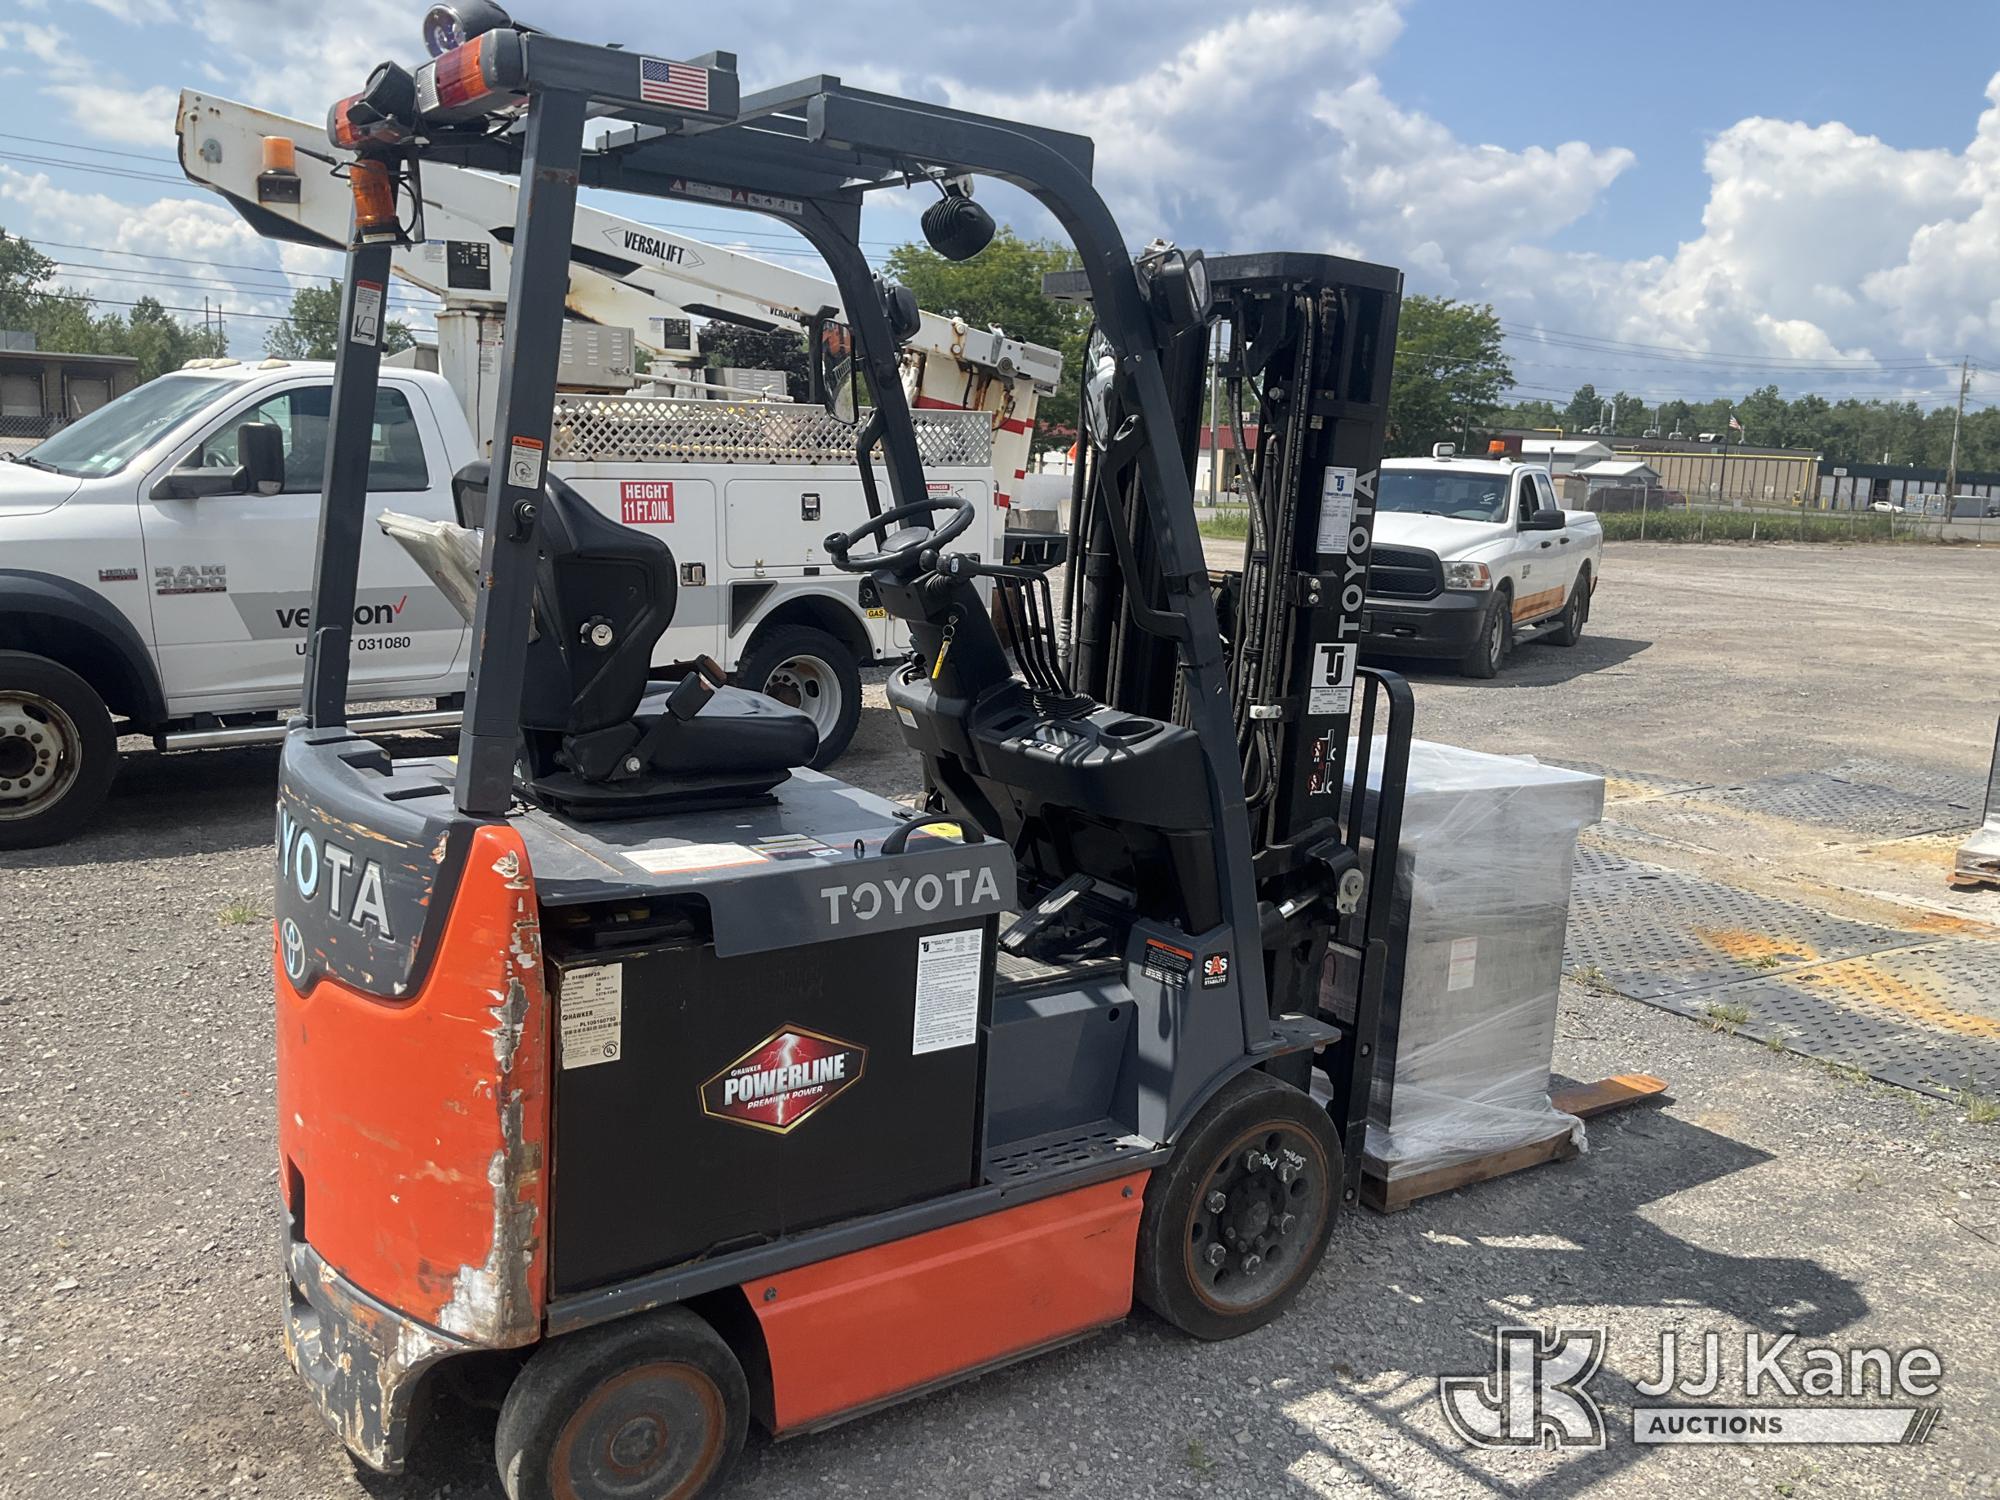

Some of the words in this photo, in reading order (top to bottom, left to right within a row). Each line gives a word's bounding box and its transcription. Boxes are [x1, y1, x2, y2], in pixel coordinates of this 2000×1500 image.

[624, 230, 685, 265] VERSALIFT
[625, 484, 669, 499] HEIGHT
[1338, 468, 1378, 639] TOYOTA
[276, 604, 393, 629] veon
[357, 636, 411, 651] 031080
[282, 808, 395, 943] YOTA
[820, 866, 1001, 925] TOYOTA
[1204, 956, 1228, 976] SAS
[724, 1053, 845, 1106] POWERLINE
[791, 1085, 824, 1100] POWER
